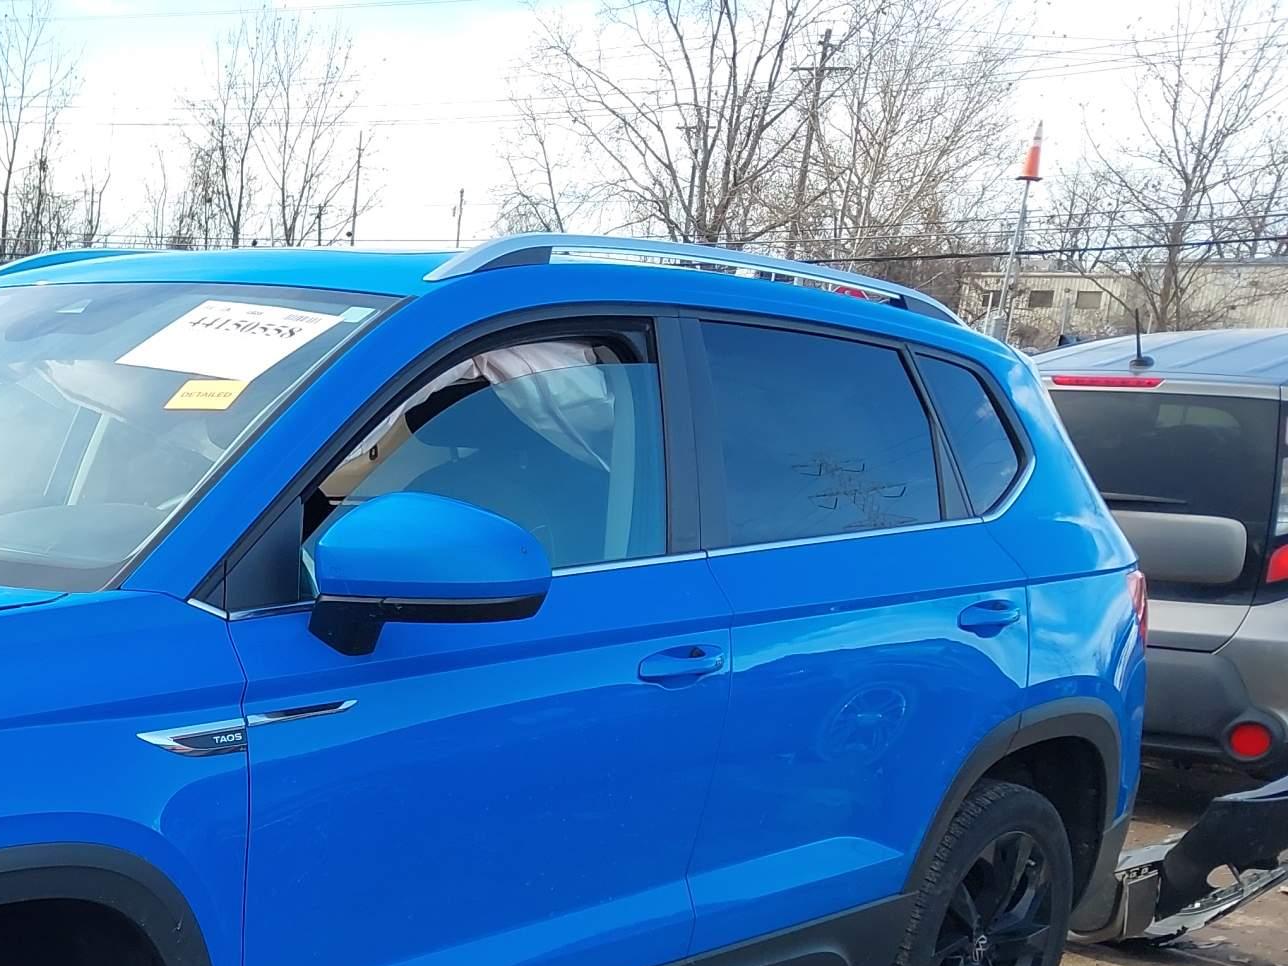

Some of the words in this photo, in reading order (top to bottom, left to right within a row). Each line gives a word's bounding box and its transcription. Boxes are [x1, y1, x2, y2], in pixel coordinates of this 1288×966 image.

[188, 316, 303, 338] 44150558
[179, 391, 233, 399] DETAILED
[213, 732, 243, 744] TAOS
